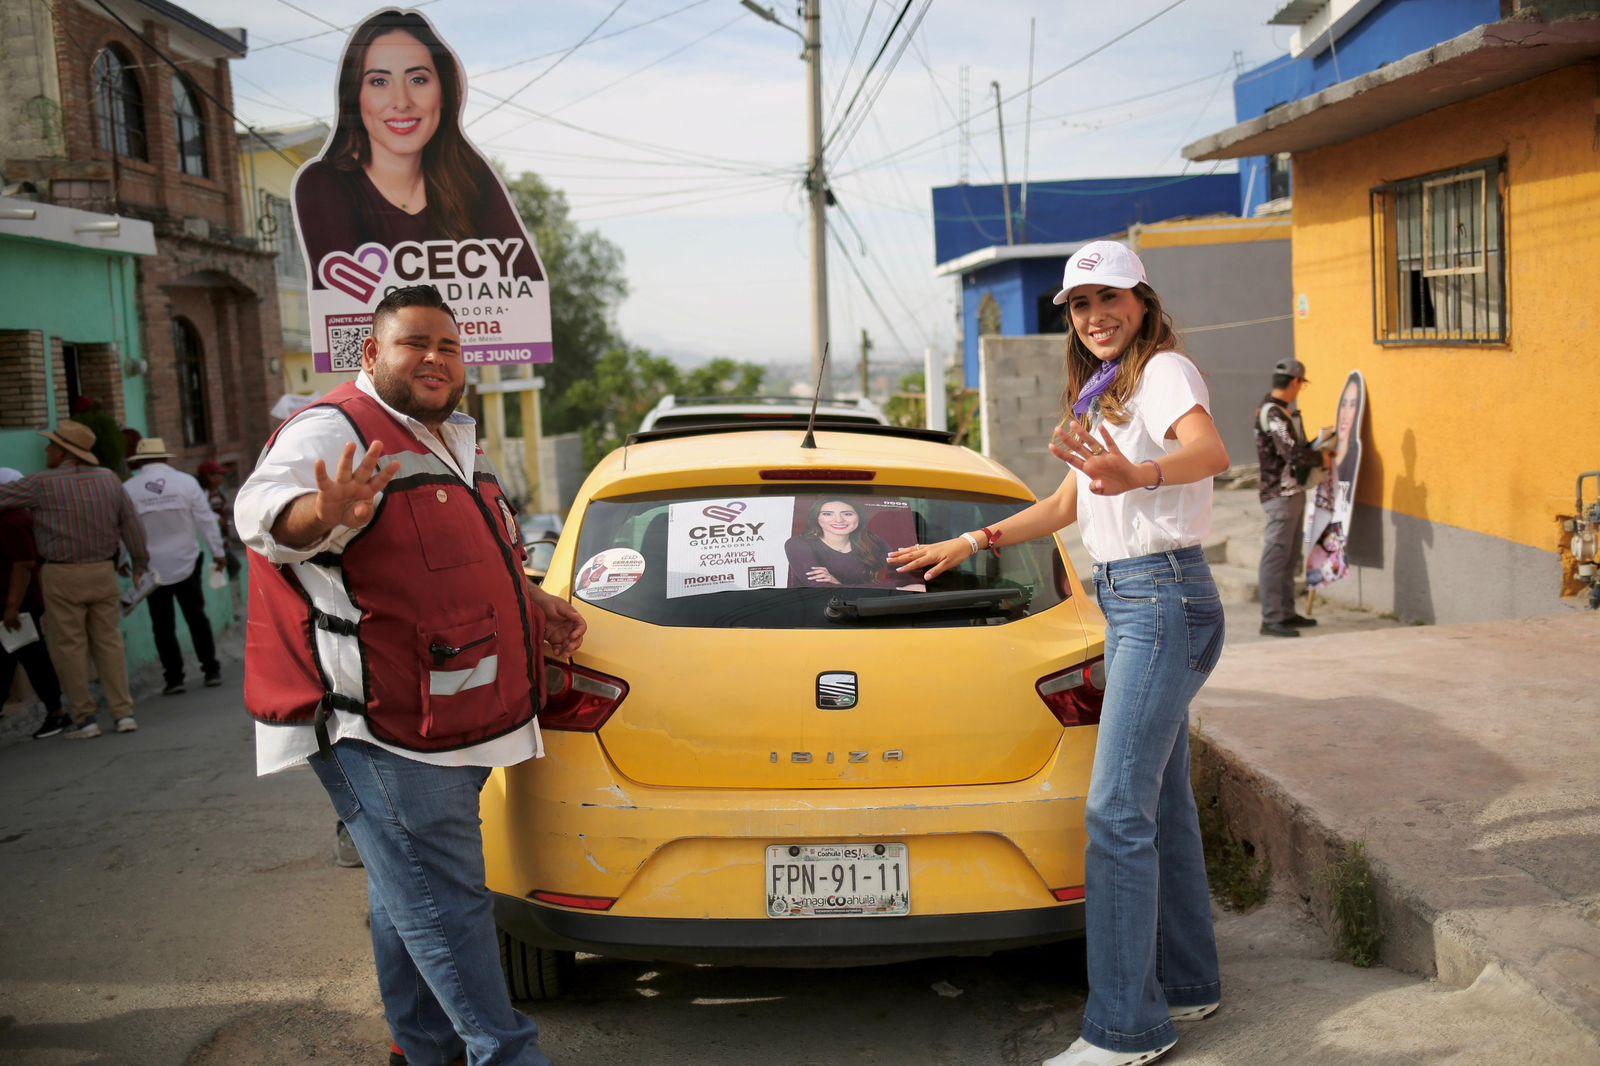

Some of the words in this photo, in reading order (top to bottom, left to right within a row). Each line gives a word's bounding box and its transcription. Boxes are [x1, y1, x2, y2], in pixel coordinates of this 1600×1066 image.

[393, 243, 518, 281] CECY
[458, 320, 502, 336] rena
[463, 351, 484, 363] DE
[486, 348, 532, 362] JUNIO
[688, 522, 765, 540] CECY
[689, 535, 765, 547] GUADIANA
[709, 557, 756, 566] COAHUILA
[684, 573, 735, 585] morena
[769, 750, 904, 764] IBIZA
[772, 863, 901, 895] FPN-91-11
